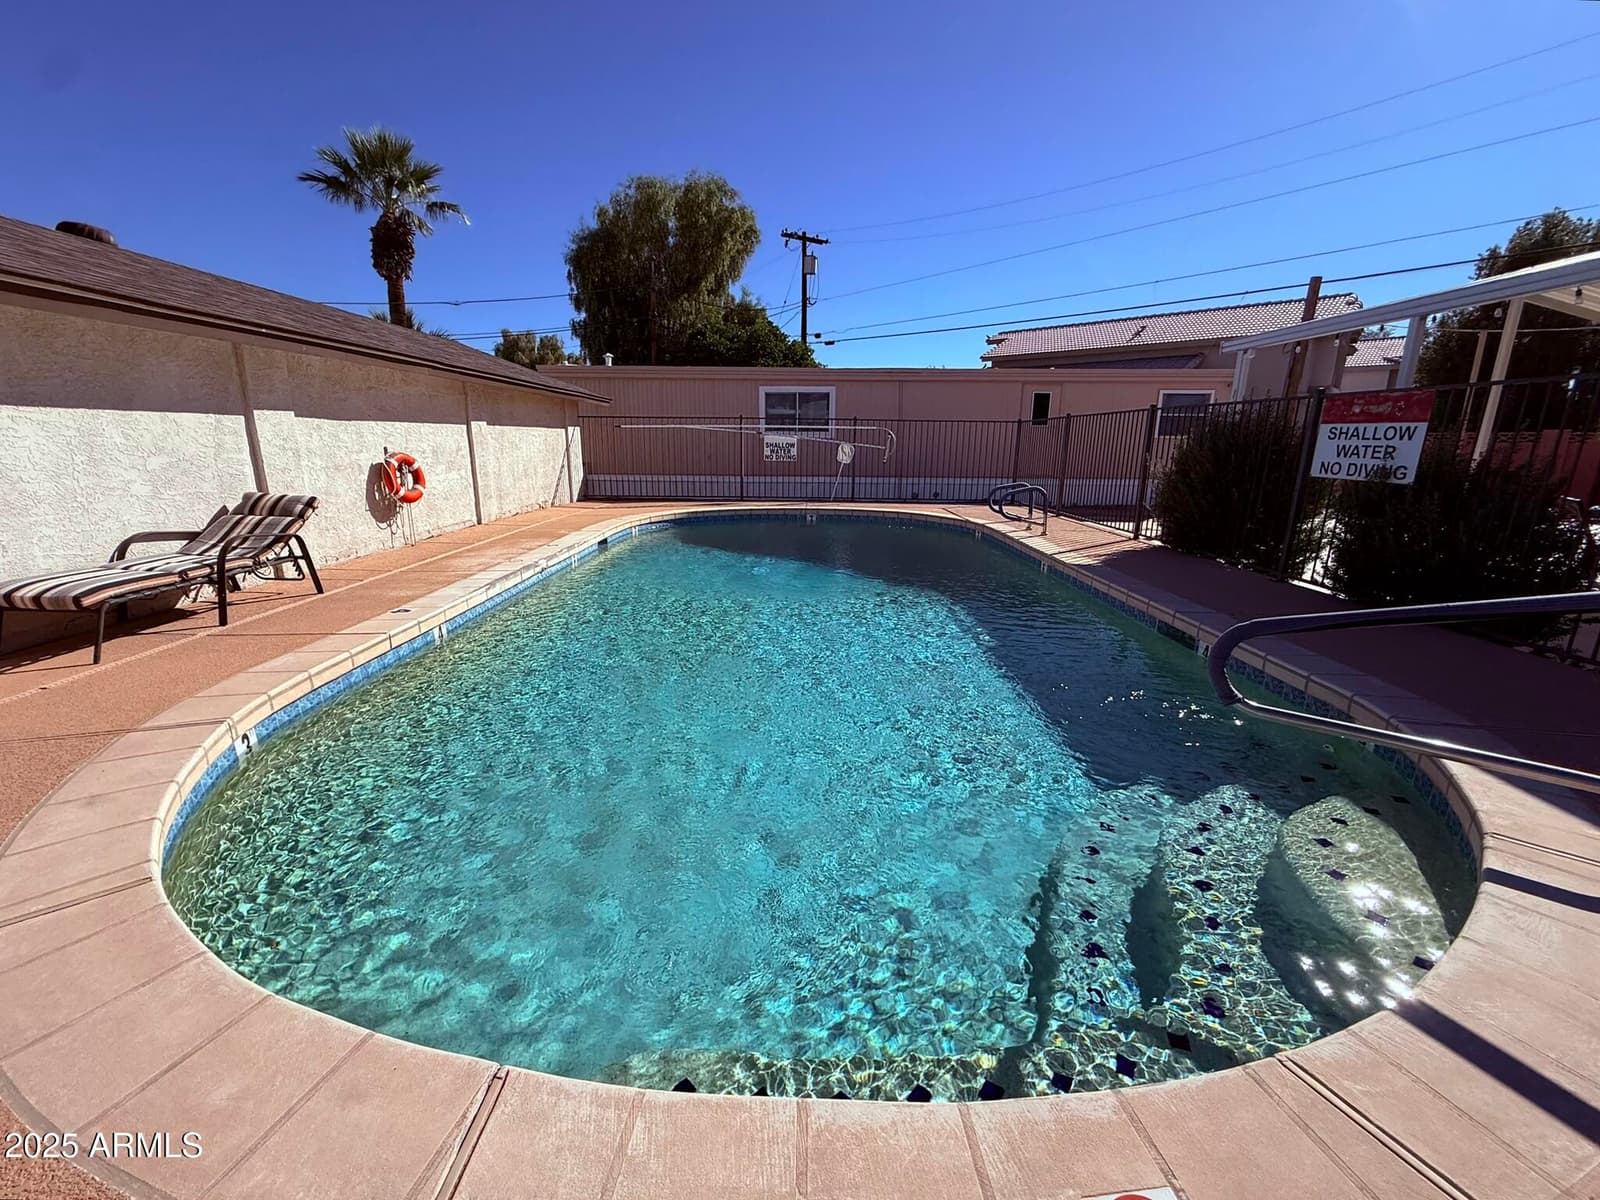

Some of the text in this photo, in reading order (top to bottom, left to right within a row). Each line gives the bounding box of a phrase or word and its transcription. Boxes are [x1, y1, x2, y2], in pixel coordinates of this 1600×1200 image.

[1327, 425, 1418, 441] SHALLOW
[1336, 444, 1397, 461] WATER
[1320, 461, 1409, 481] NO DIVG
